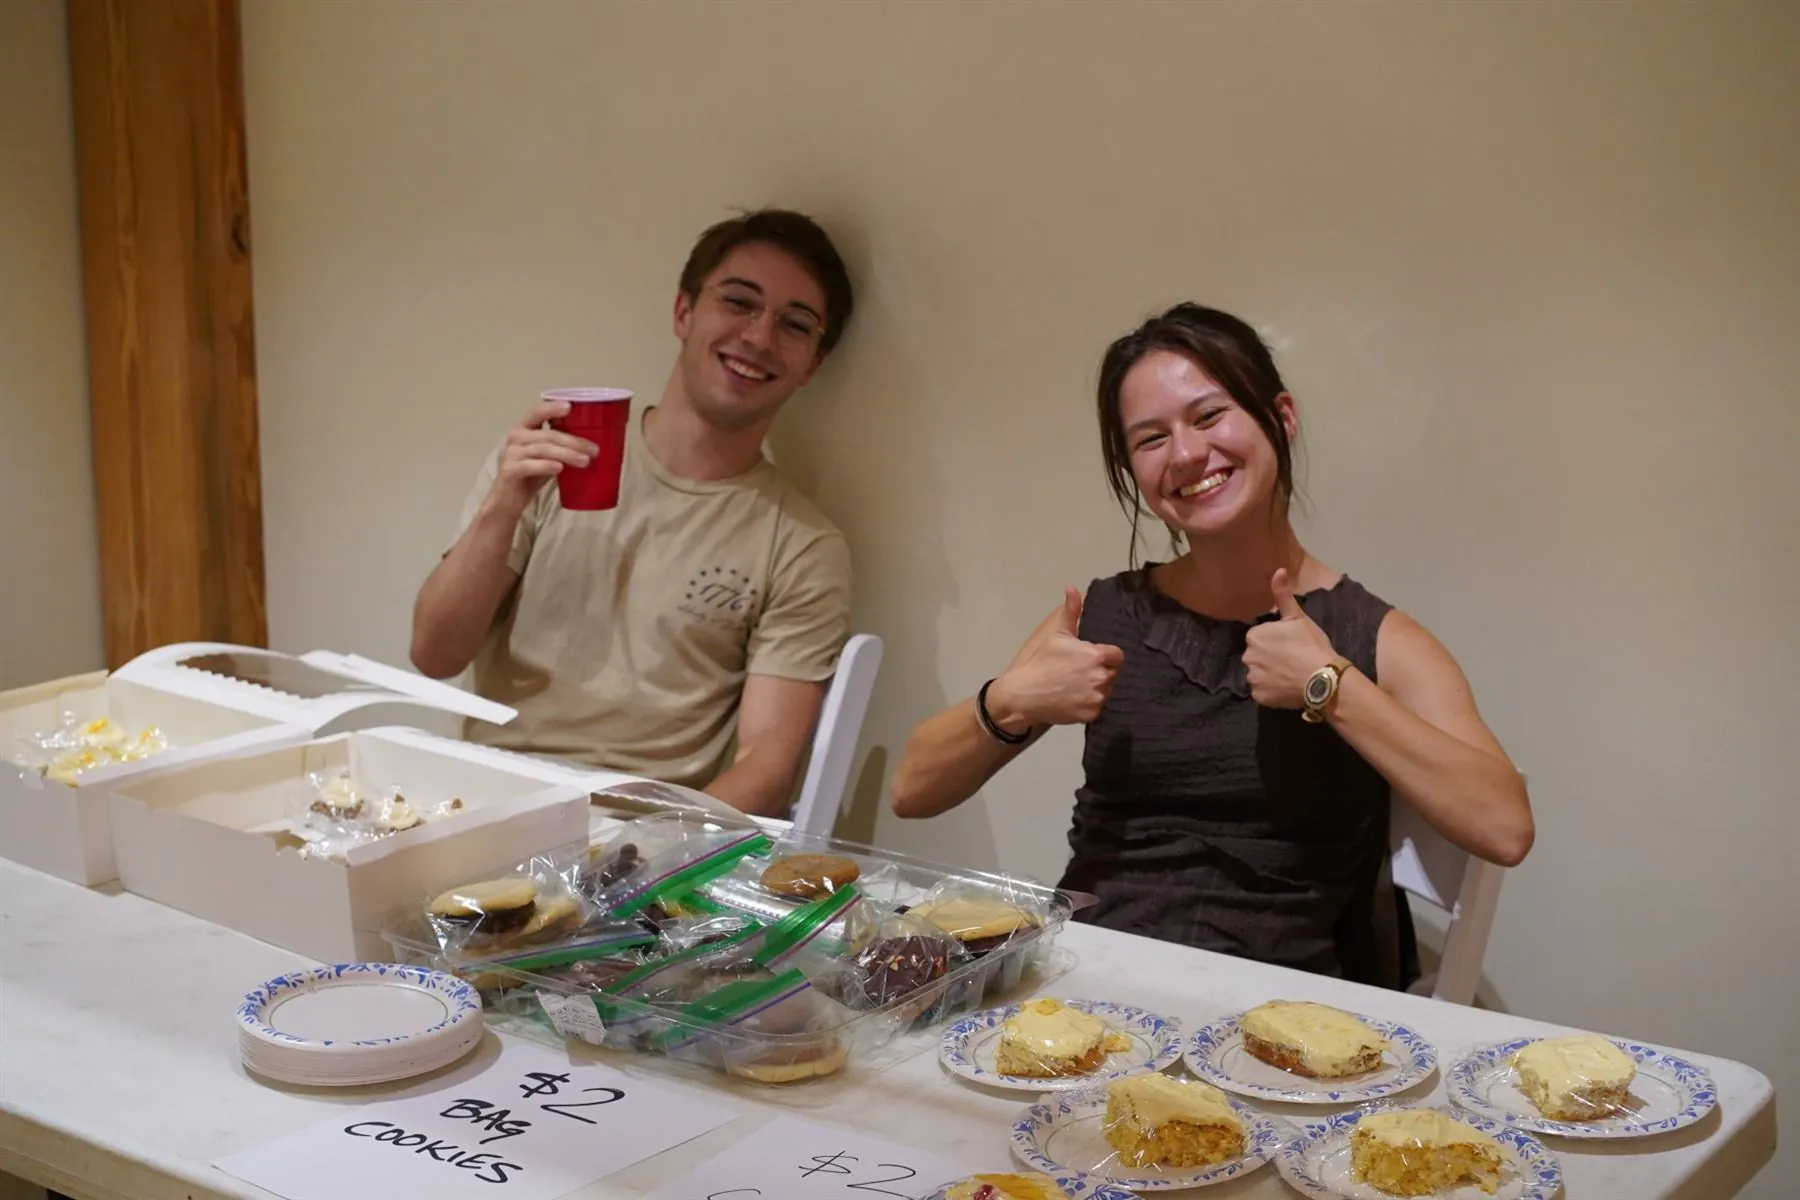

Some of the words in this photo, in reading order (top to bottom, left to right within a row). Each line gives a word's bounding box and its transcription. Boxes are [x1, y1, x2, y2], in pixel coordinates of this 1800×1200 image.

[439, 1098, 532, 1145] BAG
[518, 1072, 625, 1124] $2
[344, 1121, 524, 1185] COOKIES
[797, 1150, 917, 1200] $2
